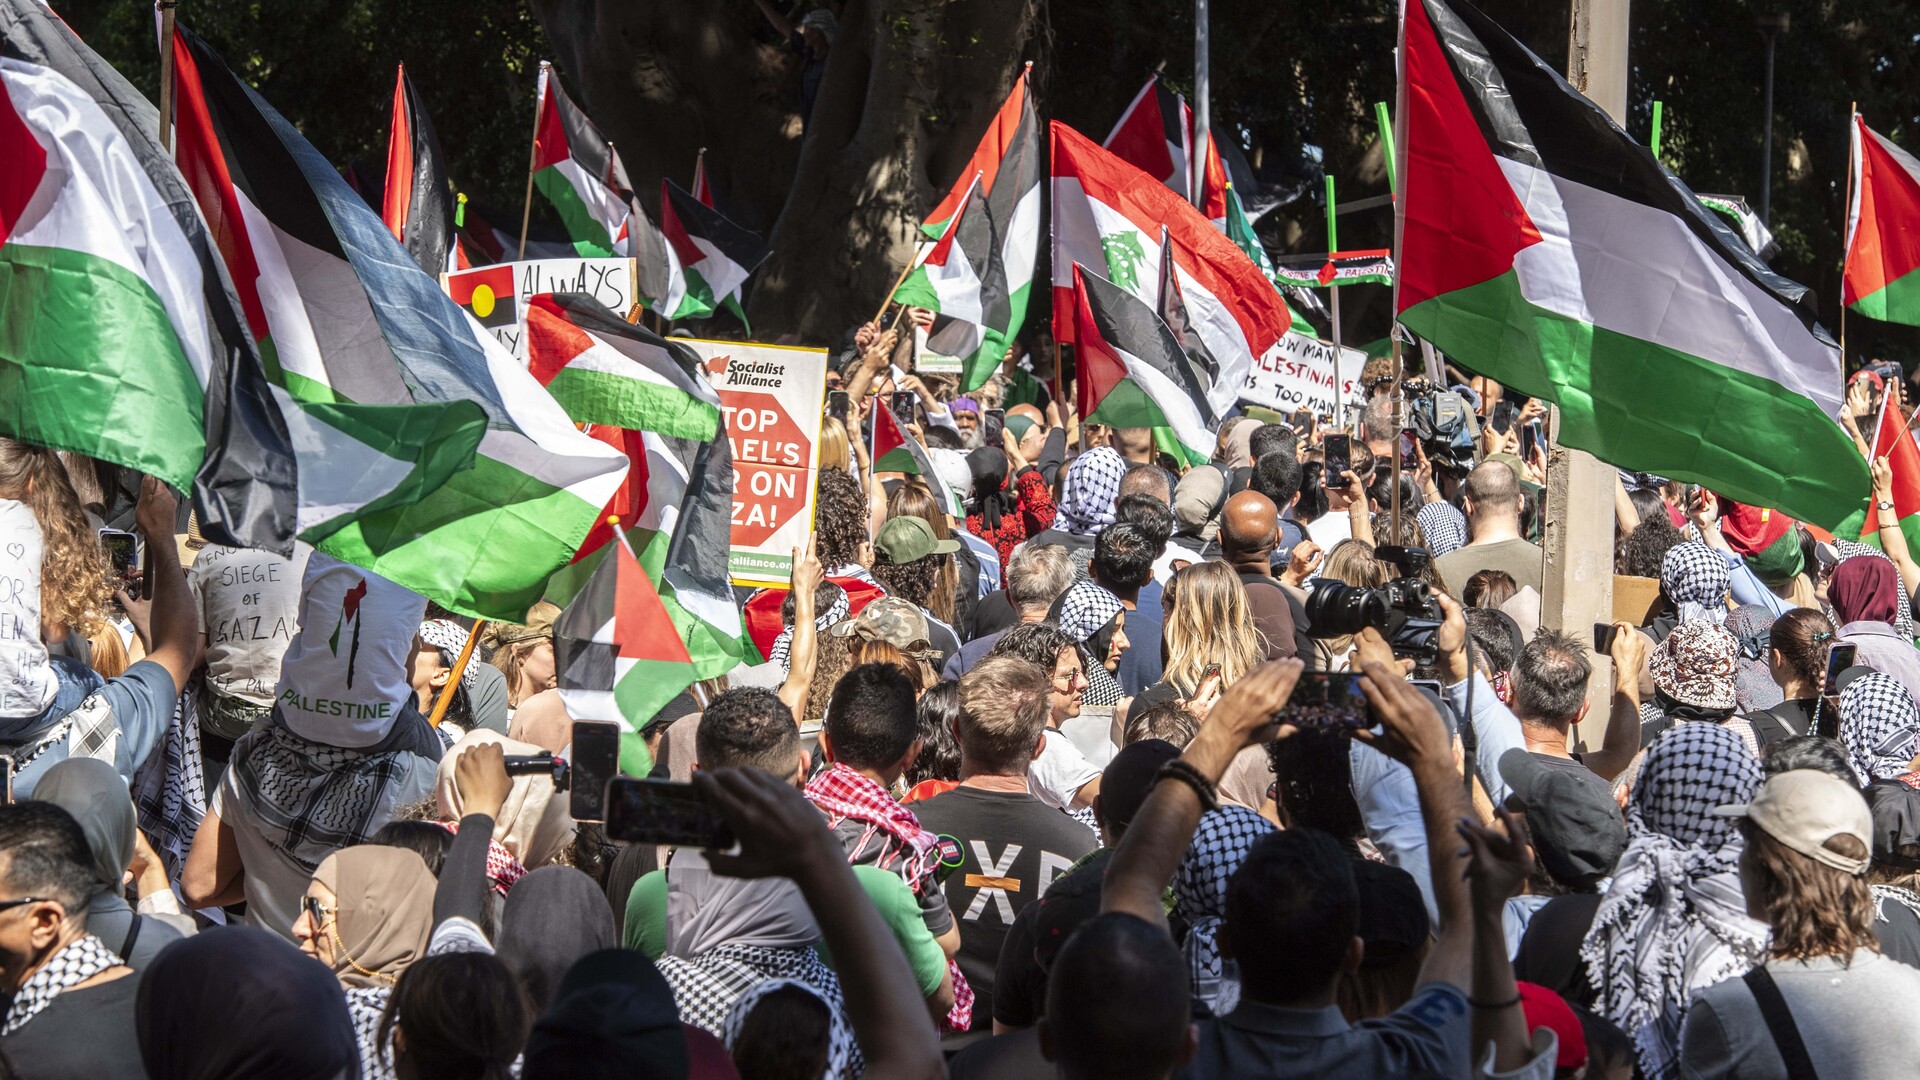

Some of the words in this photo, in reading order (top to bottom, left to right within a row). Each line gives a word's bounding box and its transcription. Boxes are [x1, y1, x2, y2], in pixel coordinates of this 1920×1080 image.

[1277, 337, 1300, 352] OW
[1303, 343, 1344, 364] MAN
[727, 371, 782, 388] Alliance
[728, 360, 785, 376] Socialist
[1257, 355, 1354, 394] LESTINIAS
[1275, 384, 1303, 404] TOO
[721, 406, 778, 433] TOP
[750, 470, 796, 499] ON
[731, 502, 777, 528] ZA!
[222, 563, 281, 586] SIEGE
[729, 556, 792, 572] -alliance.or
[0, 575, 24, 608] OR
[242, 592, 261, 606] OF
[0, 613, 24, 640] EN
[280, 688, 391, 719] PALESTINE
